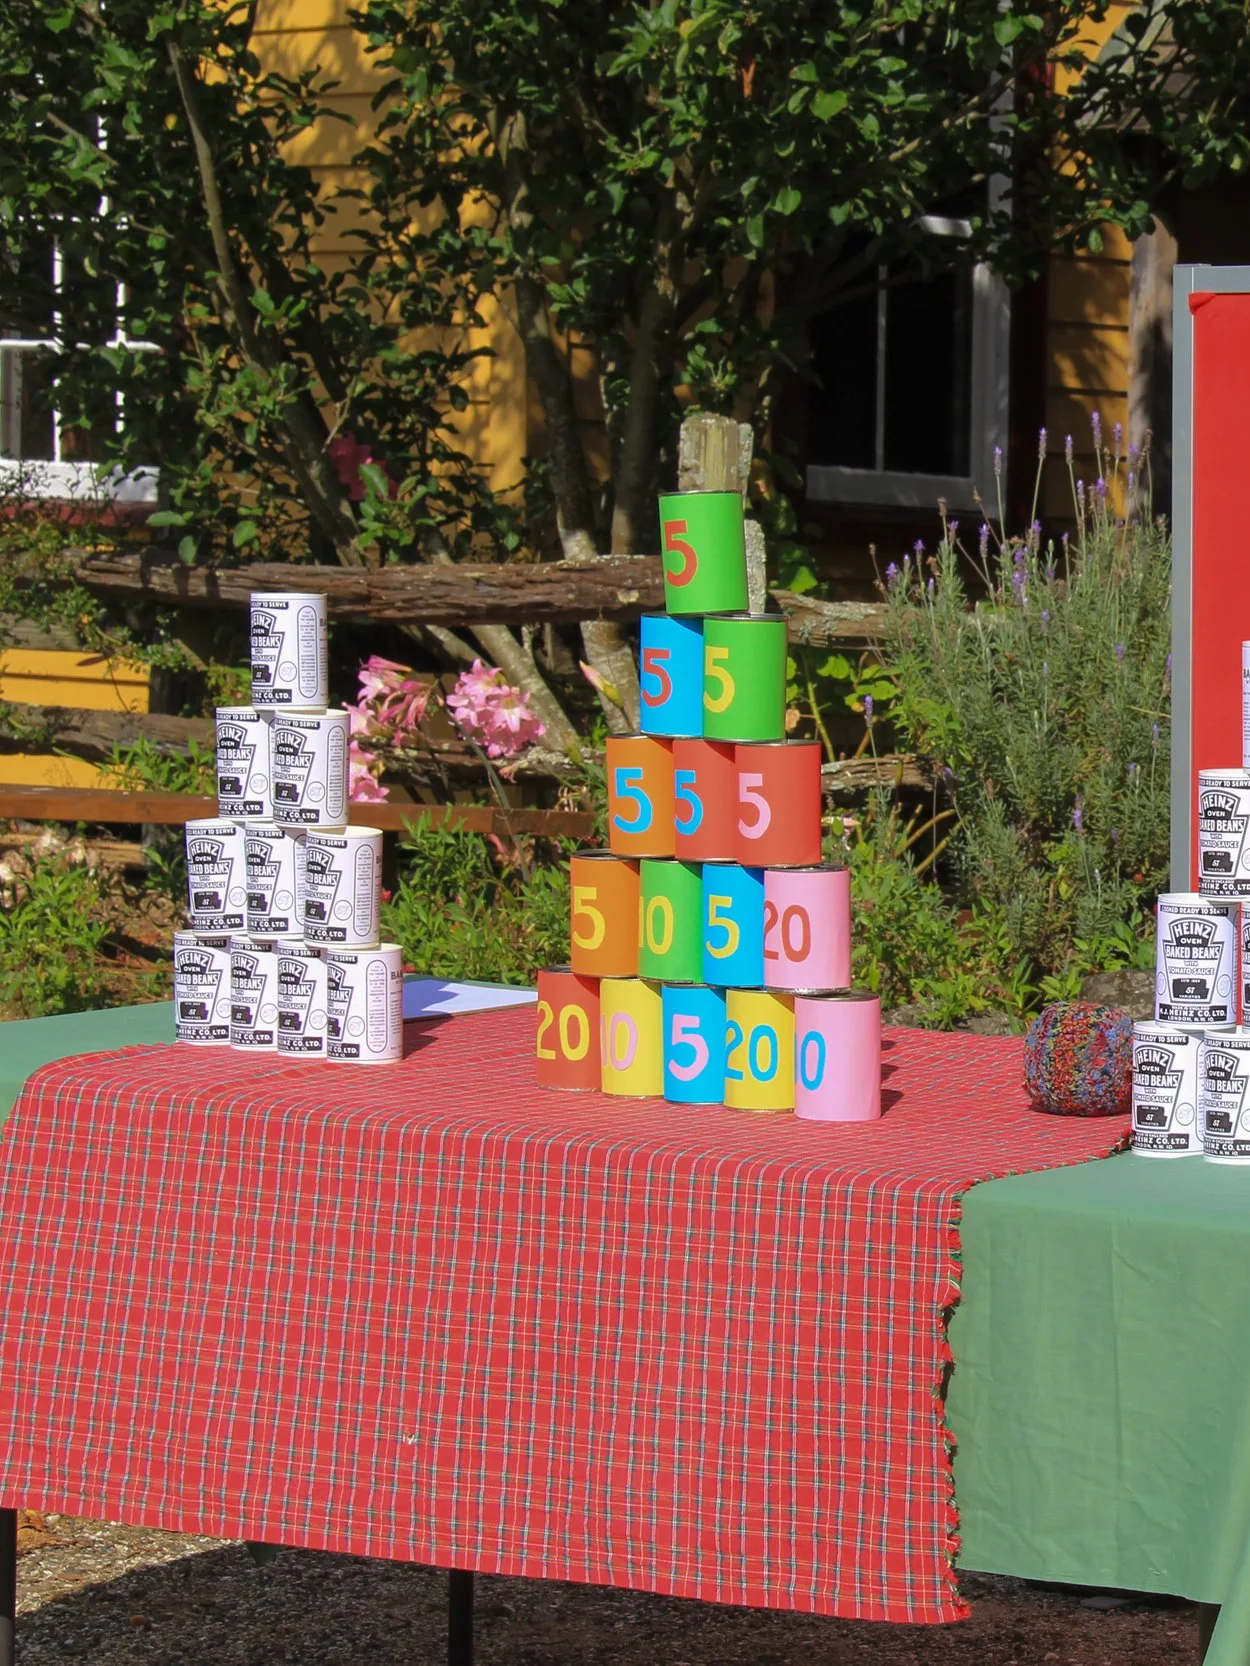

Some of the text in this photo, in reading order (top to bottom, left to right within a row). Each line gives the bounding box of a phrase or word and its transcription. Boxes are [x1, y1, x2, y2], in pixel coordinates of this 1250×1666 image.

[664, 519, 698, 587] 5
[259, 636, 280, 647] BEANS
[641, 649, 673, 707] 5
[703, 646, 736, 713] 5
[228, 748, 250, 759] BEANS
[286, 755, 310, 767] BEANS
[614, 768, 653, 833] 5
[675, 770, 703, 835] 5
[738, 773, 772, 839] 5
[1203, 795, 1236, 813] HEINZ
[1217, 819, 1244, 832] BEANS
[191, 841, 218, 856] HEINZ
[1217, 841, 1239, 849] SAUCE
[205, 862, 229, 875] BEANS
[254, 865, 276, 876] BEANS
[314, 873, 337, 886] BEANS
[573, 887, 605, 950] 5
[706, 895, 740, 959] 5
[764, 900, 811, 963] 20
[1172, 921, 1212, 939] HEINZ
[180, 952, 210, 967] HEINZ
[1165, 946, 1219, 959] BAKED BEANS
[1168, 967, 1215, 975] TOMATO SAUCE
[193, 974, 218, 985] BEANS
[240, 978, 262, 990] BEANS
[288, 984, 311, 996] BEANS
[1168, 1009, 1193, 1017] HEINZ
[1212, 1010, 1227, 1018] LTD.
[537, 1000, 590, 1061] 20
[668, 1014, 709, 1082] 5
[725, 1020, 778, 1082] 20
[1136, 1049, 1170, 1067] HEINZ
[1205, 1053, 1233, 1072] HEINZ
[1152, 1074, 1178, 1087] BEANS
[1217, 1080, 1243, 1092] BEANS
[1153, 1095, 1173, 1103] SAUCE
[1171, 1137, 1187, 1145] LTD.
